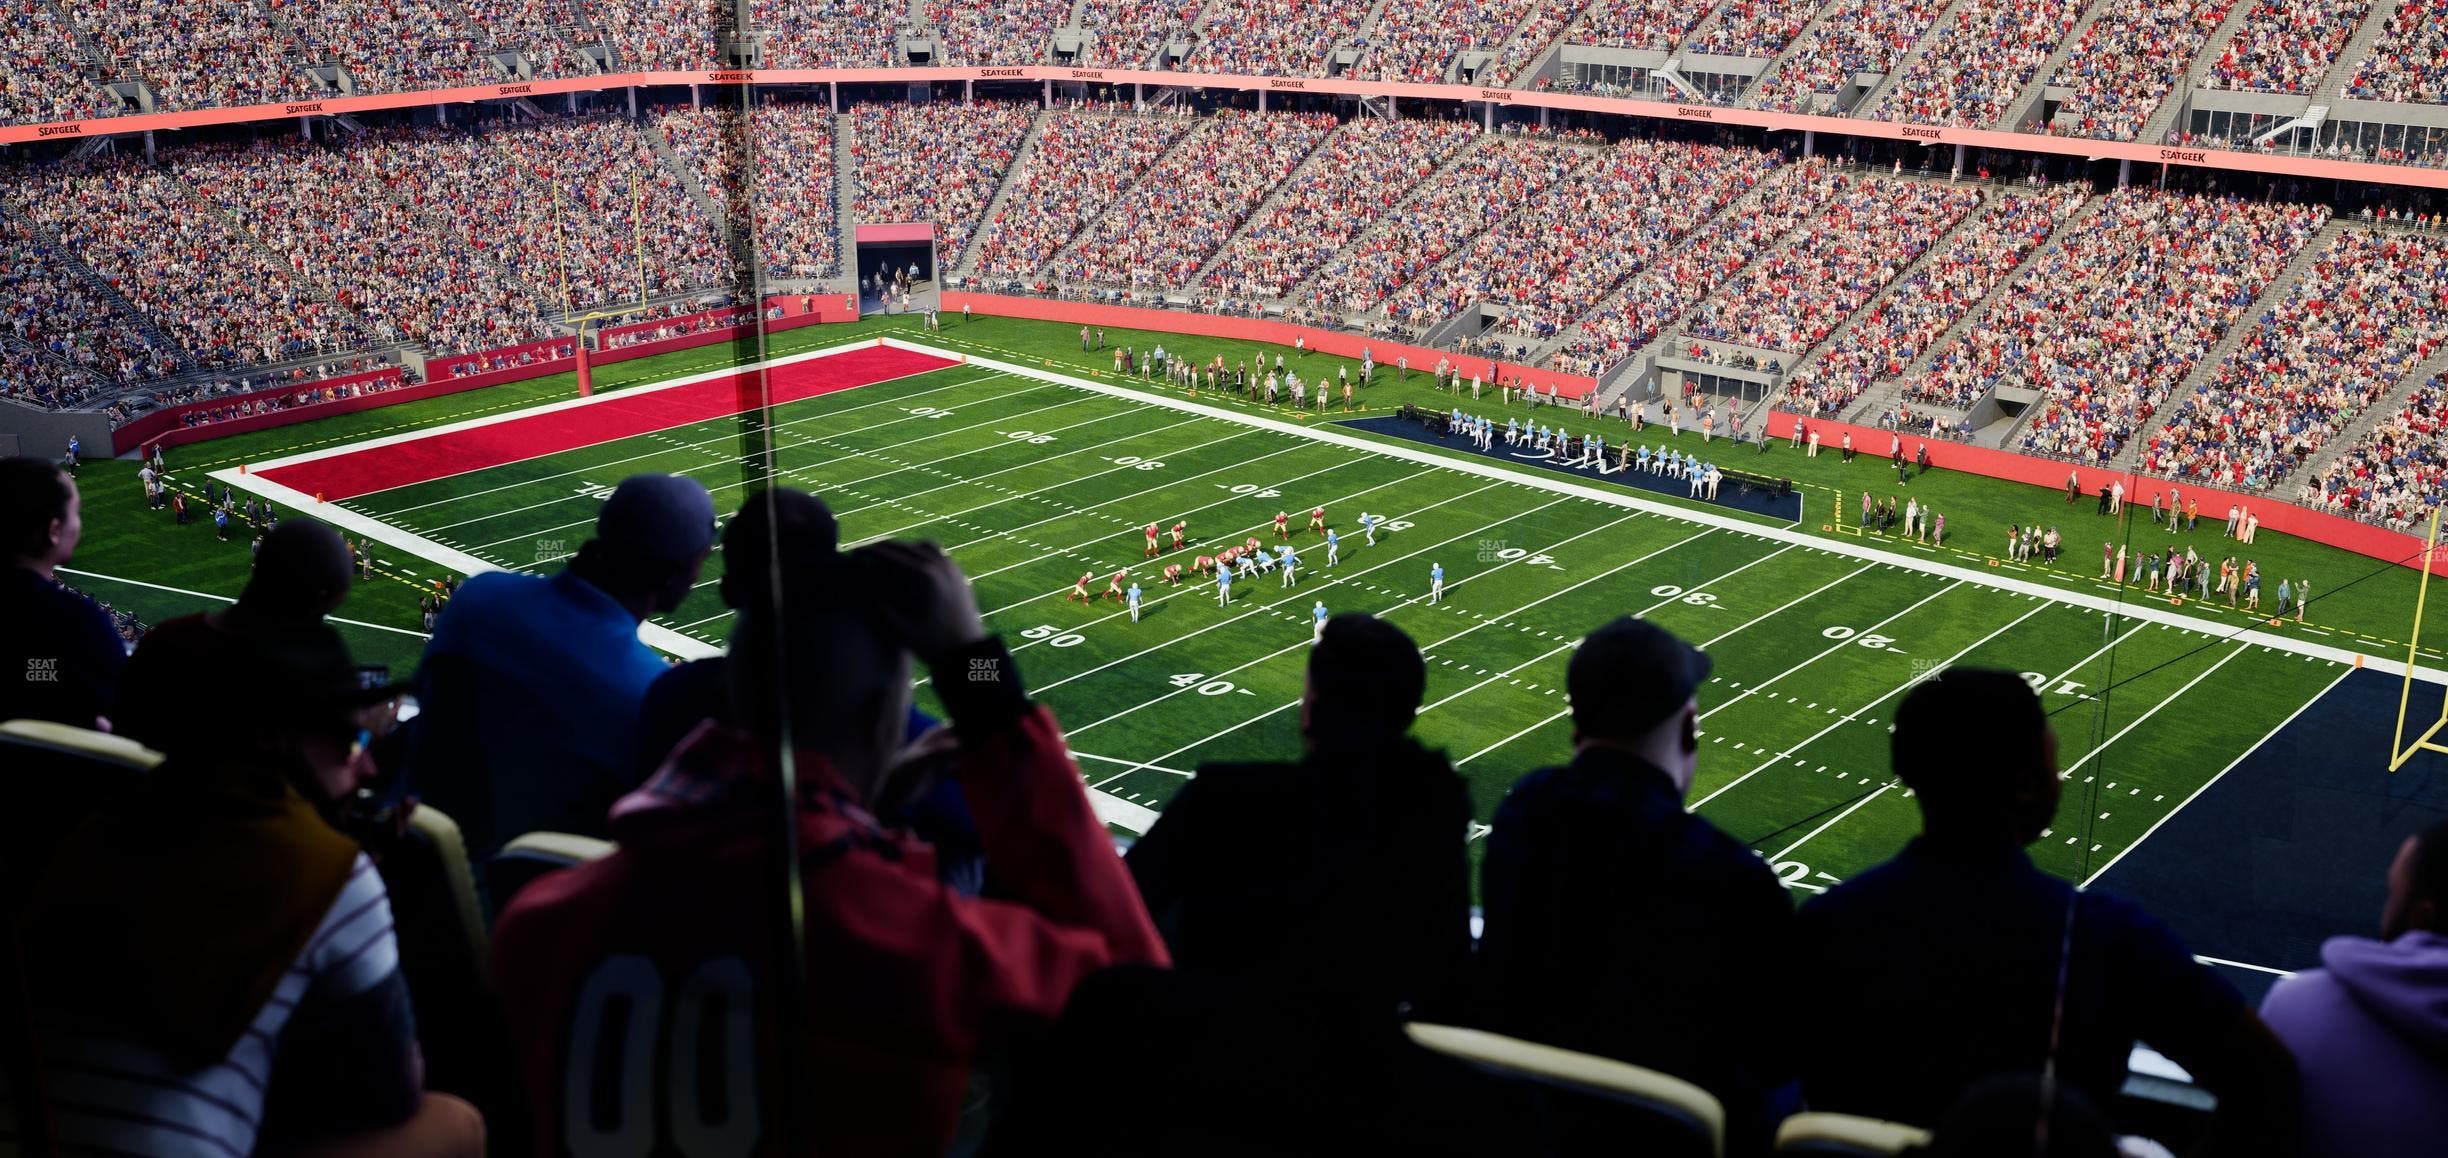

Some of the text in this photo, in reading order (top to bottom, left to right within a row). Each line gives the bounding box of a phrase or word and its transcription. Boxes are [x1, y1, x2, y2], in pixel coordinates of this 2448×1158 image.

[709, 73, 753, 81] SEATGEEK
[981, 68, 1023, 77] SEATGEEK
[1072, 70, 1103, 79] SEATGEEK
[499, 83, 532, 95] SEATGEEK
[1271, 79, 1304, 89] SEATGEEK
[1482, 90, 1511, 100] SEATGEEK
[286, 103, 323, 115] SEATGEEK
[1678, 107, 1712, 119] SEATGEEK
[39, 124, 81, 137] SEATGEEK
[1902, 127, 1941, 139] SEATGEEK
[2160, 149, 2205, 163] SEATGEEK
[1651, 585, 1717, 605] 30
[1020, 624, 1085, 647] 50
[1822, 626, 1896, 648] 20
[1168, 673, 1234, 695] 40
[563, 952, 761, 1158] 00
